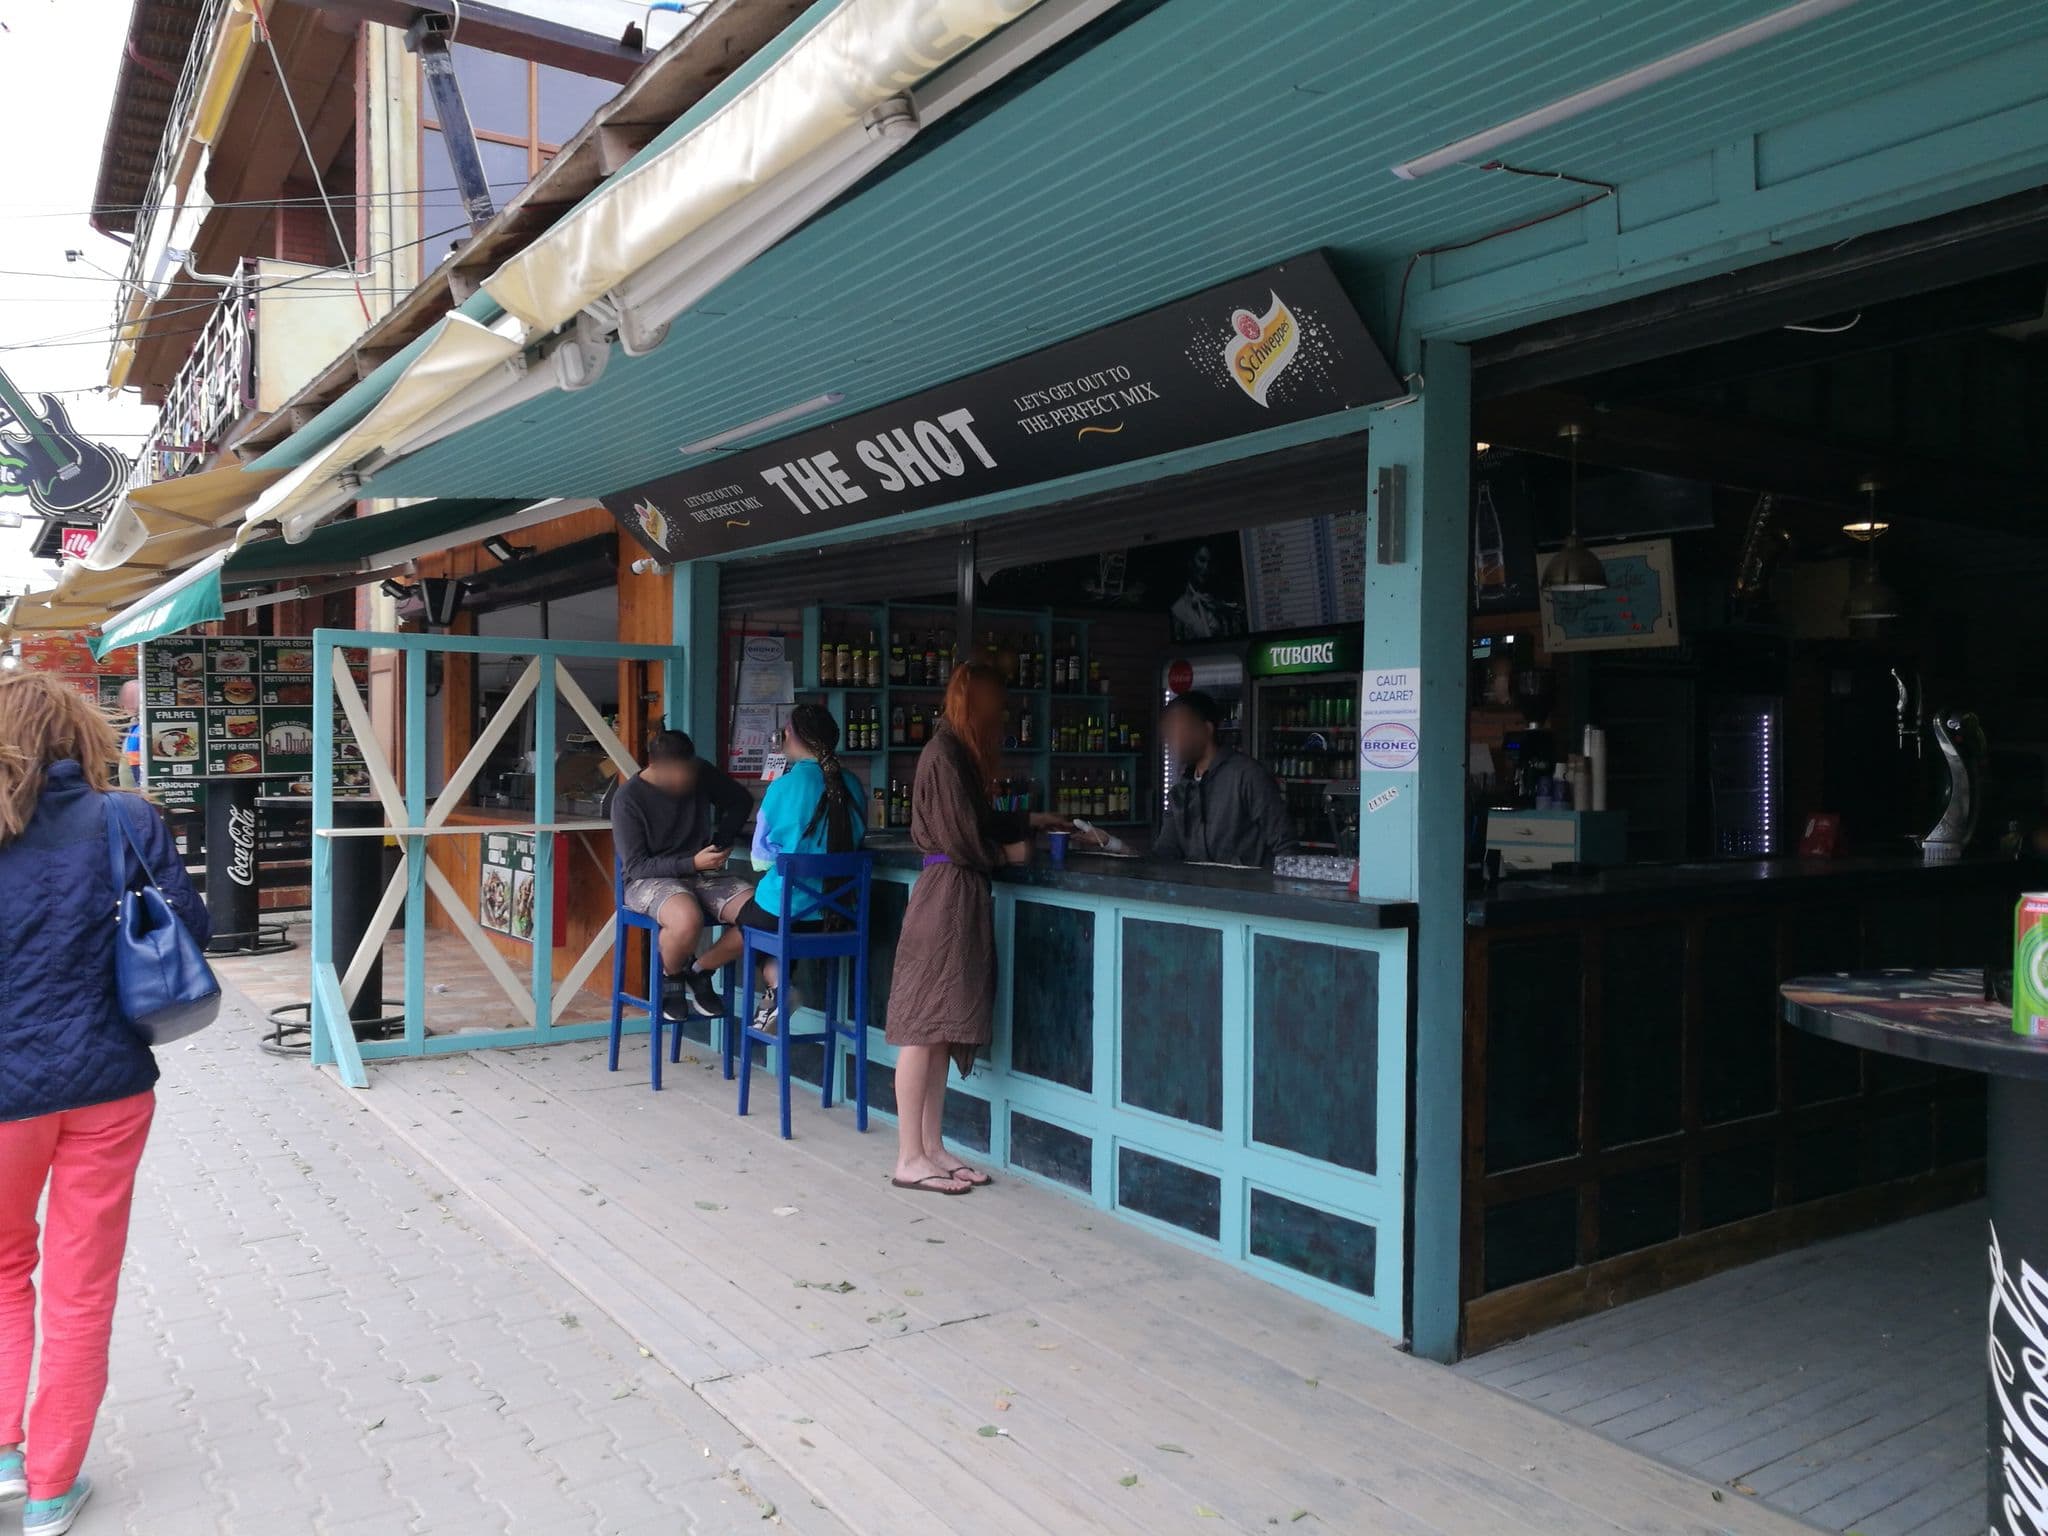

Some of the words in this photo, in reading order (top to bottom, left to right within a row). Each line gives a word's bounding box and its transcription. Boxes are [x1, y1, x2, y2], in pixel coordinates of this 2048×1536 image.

[1239, 320, 1290, 384] Schweppes
[1014, 391, 1051, 412] LET'S
[1048, 381, 1078, 401] GET
[1076, 372, 1108, 392] OUT
[1105, 365, 1131, 383] TO
[1017, 414, 1053, 435] THE
[1049, 393, 1121, 426] PERFECT
[1119, 382, 1160, 406] MIX
[760, 450, 868, 515] THE
[855, 407, 998, 493] SHOT
[683, 495, 705, 508] LET'S
[701, 491, 718, 502] GET
[714, 487, 733, 499] OUT
[729, 484, 744, 496] TO
[690, 509, 712, 523] THE
[705, 500, 745, 519] PERFECT
[739, 496, 764, 511] MIX
[1269, 641, 1334, 668] TUBORG
[1376, 674, 1407, 686] CAUTI
[1369, 690, 1414, 702] CAZARE?
[156, 711, 197, 719] FALAFEL
[1364, 741, 1417, 750] BRONEC
[226, 804, 256, 886] Coca-Cola
